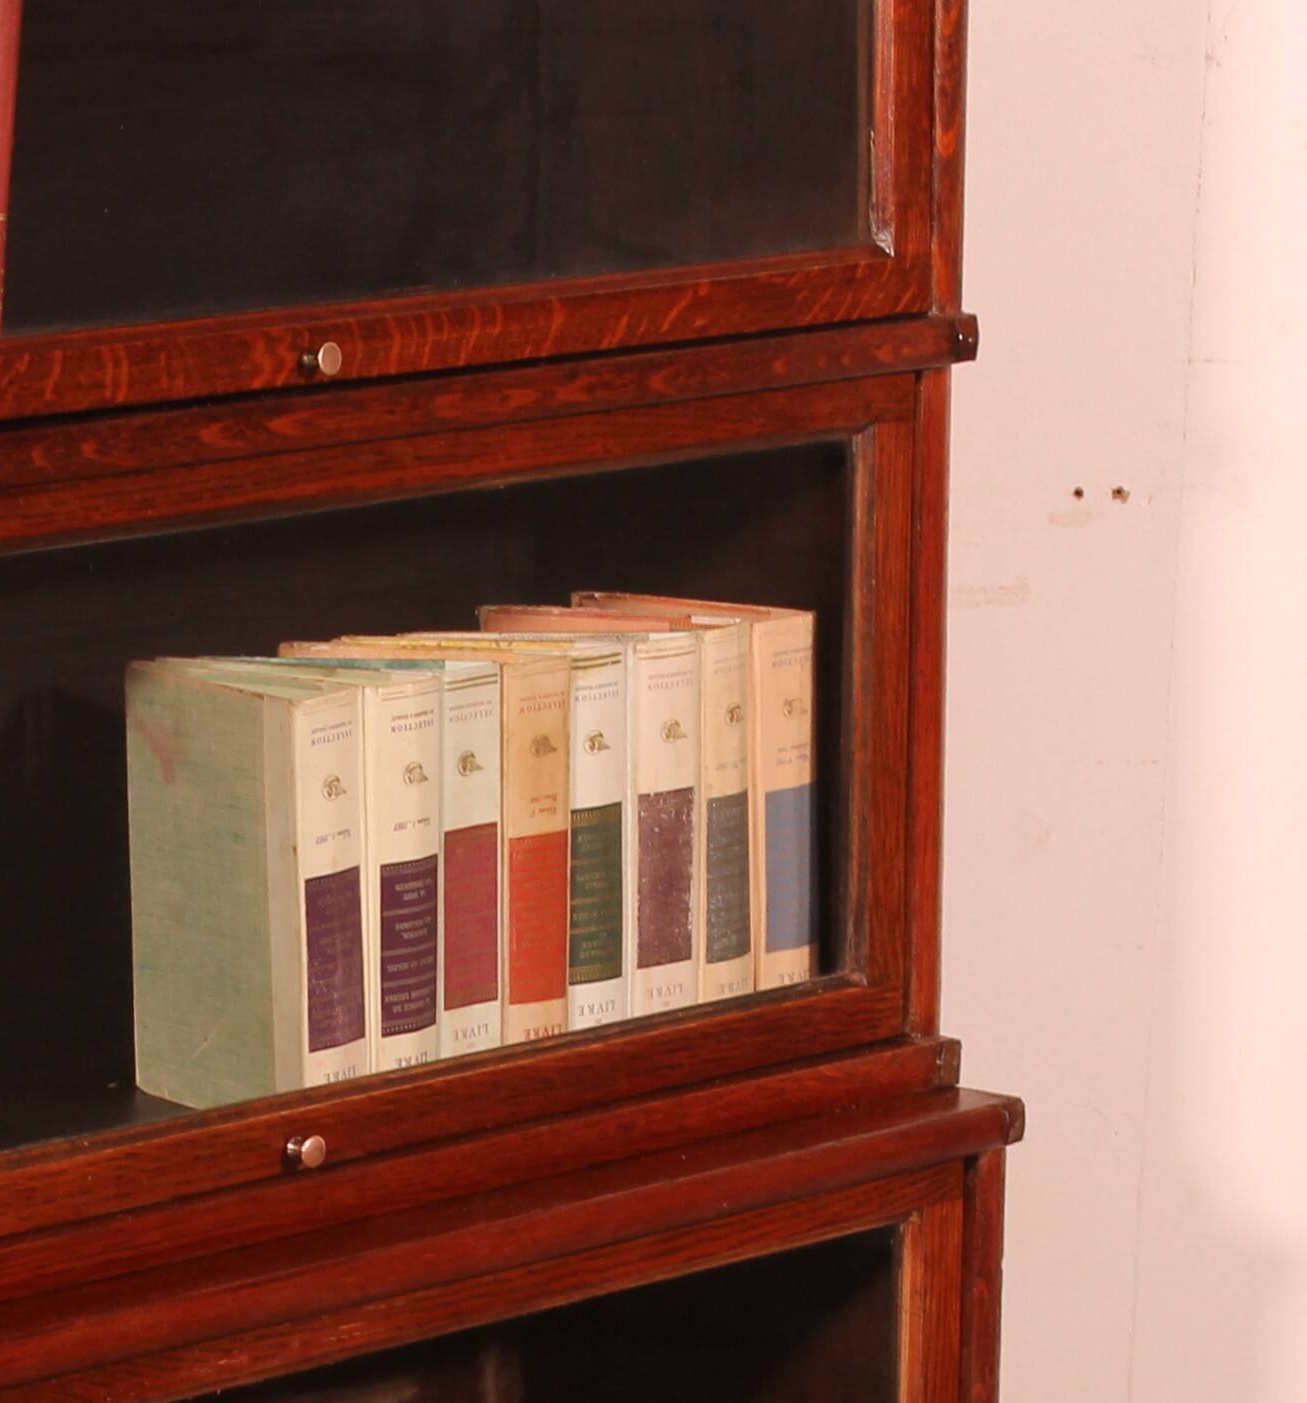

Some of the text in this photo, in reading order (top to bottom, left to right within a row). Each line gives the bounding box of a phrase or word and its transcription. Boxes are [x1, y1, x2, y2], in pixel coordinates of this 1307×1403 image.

[578, 999, 615, 1017] LIVRE
[453, 1023, 489, 1042] LIVRE
[524, 1023, 562, 1041] LIVRE
[394, 1050, 427, 1068] LIVRE
